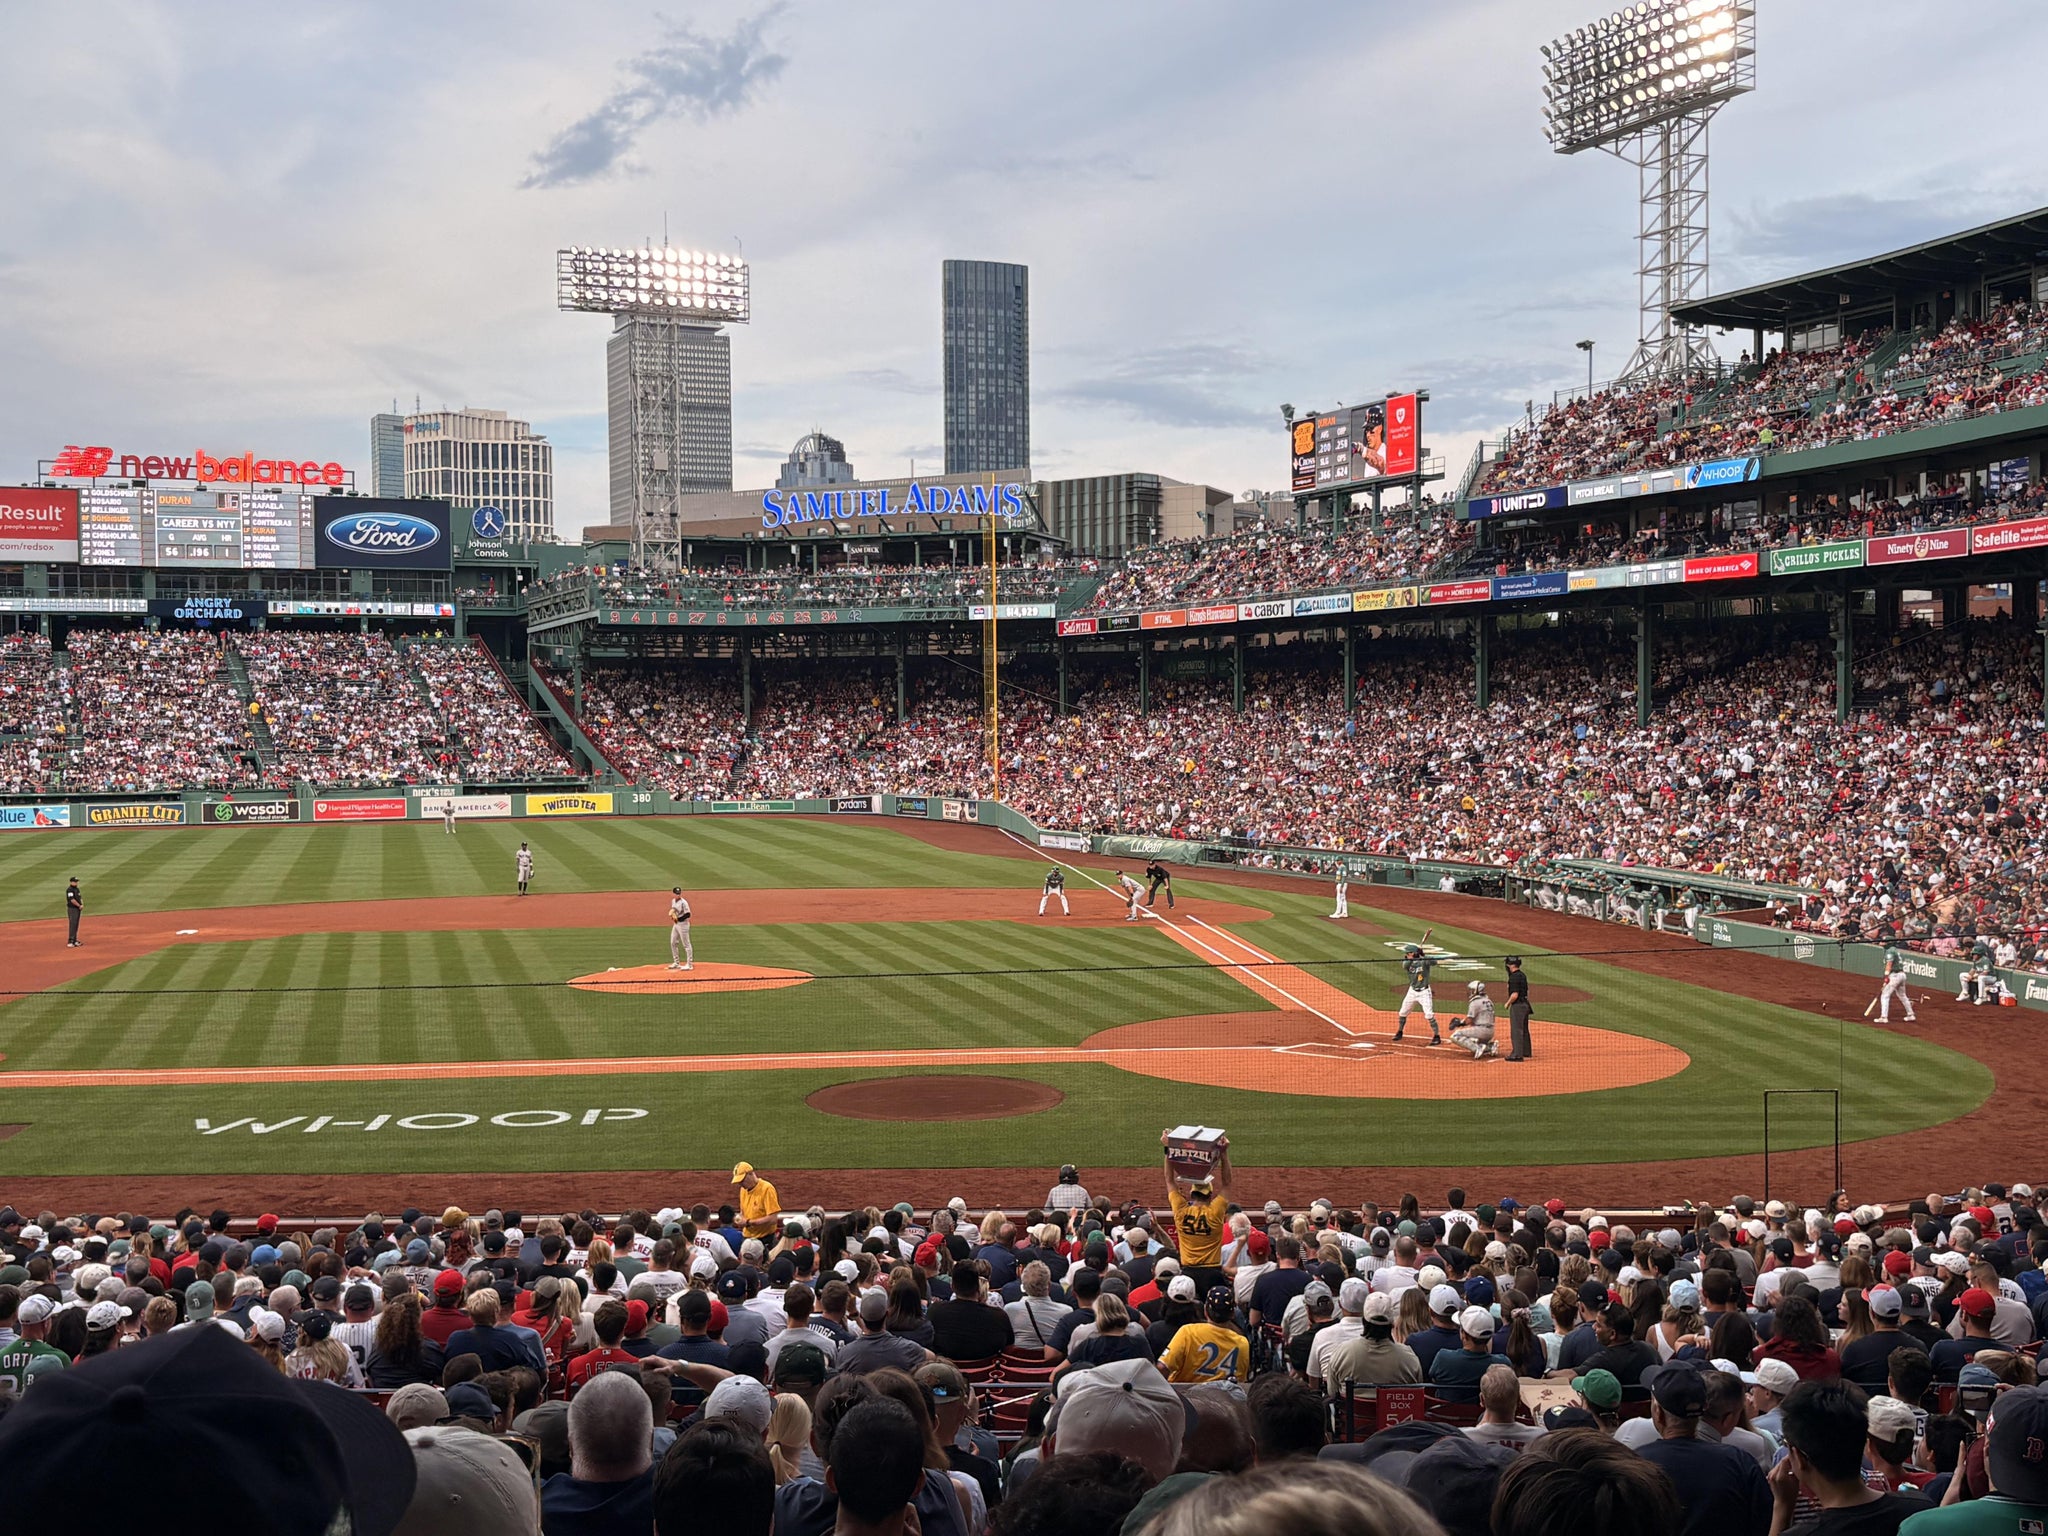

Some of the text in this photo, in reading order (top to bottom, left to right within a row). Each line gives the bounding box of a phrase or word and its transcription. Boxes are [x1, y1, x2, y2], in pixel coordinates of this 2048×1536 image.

[1318, 416, 1336, 429] DURAN
[1321, 430, 1329, 439] AVG
[121, 448, 344, 486] new balance
[1703, 468, 1741, 481] WHOOP
[91, 489, 139, 497] GOLDSCHMIDT
[1575, 485, 1615, 499] PITCH BREAK
[159, 496, 192, 505] DURAN
[252, 502, 284, 510] RAFAELA
[762, 489, 898, 529] SAMUEL
[901, 481, 1023, 518] ADAMS
[1503, 492, 1546, 512] UNITED
[162, 519, 235, 529] CAREER VS NYY
[221, 534, 232, 542] HR
[349, 518, 417, 547] Ford
[468, 540, 502, 549] Johnson
[1975, 530, 2020, 548] Safelite
[165, 548, 178, 556] 56
[190, 548, 209, 557] .196
[1887, 543, 1914, 555] Ninety
[1929, 538, 1949, 550] Nine
[474, 548, 509, 558] Controls
[1784, 548, 1860, 567] GRILLO'S PICKLES
[1688, 564, 1739, 576] BANK OF AMERICA
[1570, 578, 1597, 590] WARREN
[184, 597, 232, 608] ANGRY
[174, 608, 243, 619] ORCHARD
[610, 610, 862, 624] 9 4 1 8 27 6 14 45 26 34 42
[1154, 615, 1172, 625] STIHL
[412, 788, 440, 797] DICK'S
[633, 793, 651, 803] 380
[235, 801, 290, 815] wasabi
[458, 804, 493, 812] AMERICA
[542, 800, 597, 813] TWISTED TEA
[91, 805, 183, 823] GRANITE CITY
[1713, 932, 1732, 943] cruises
[1903, 961, 1938, 978] artwater
[195, 1107, 649, 1135] WHOOP
[3, 1352, 33, 1369] ORTI
[1193, 1341, 1240, 1376] 24
[1386, 1393, 1415, 1401] FIELD
[2022, 1436, 2045, 1463] B
